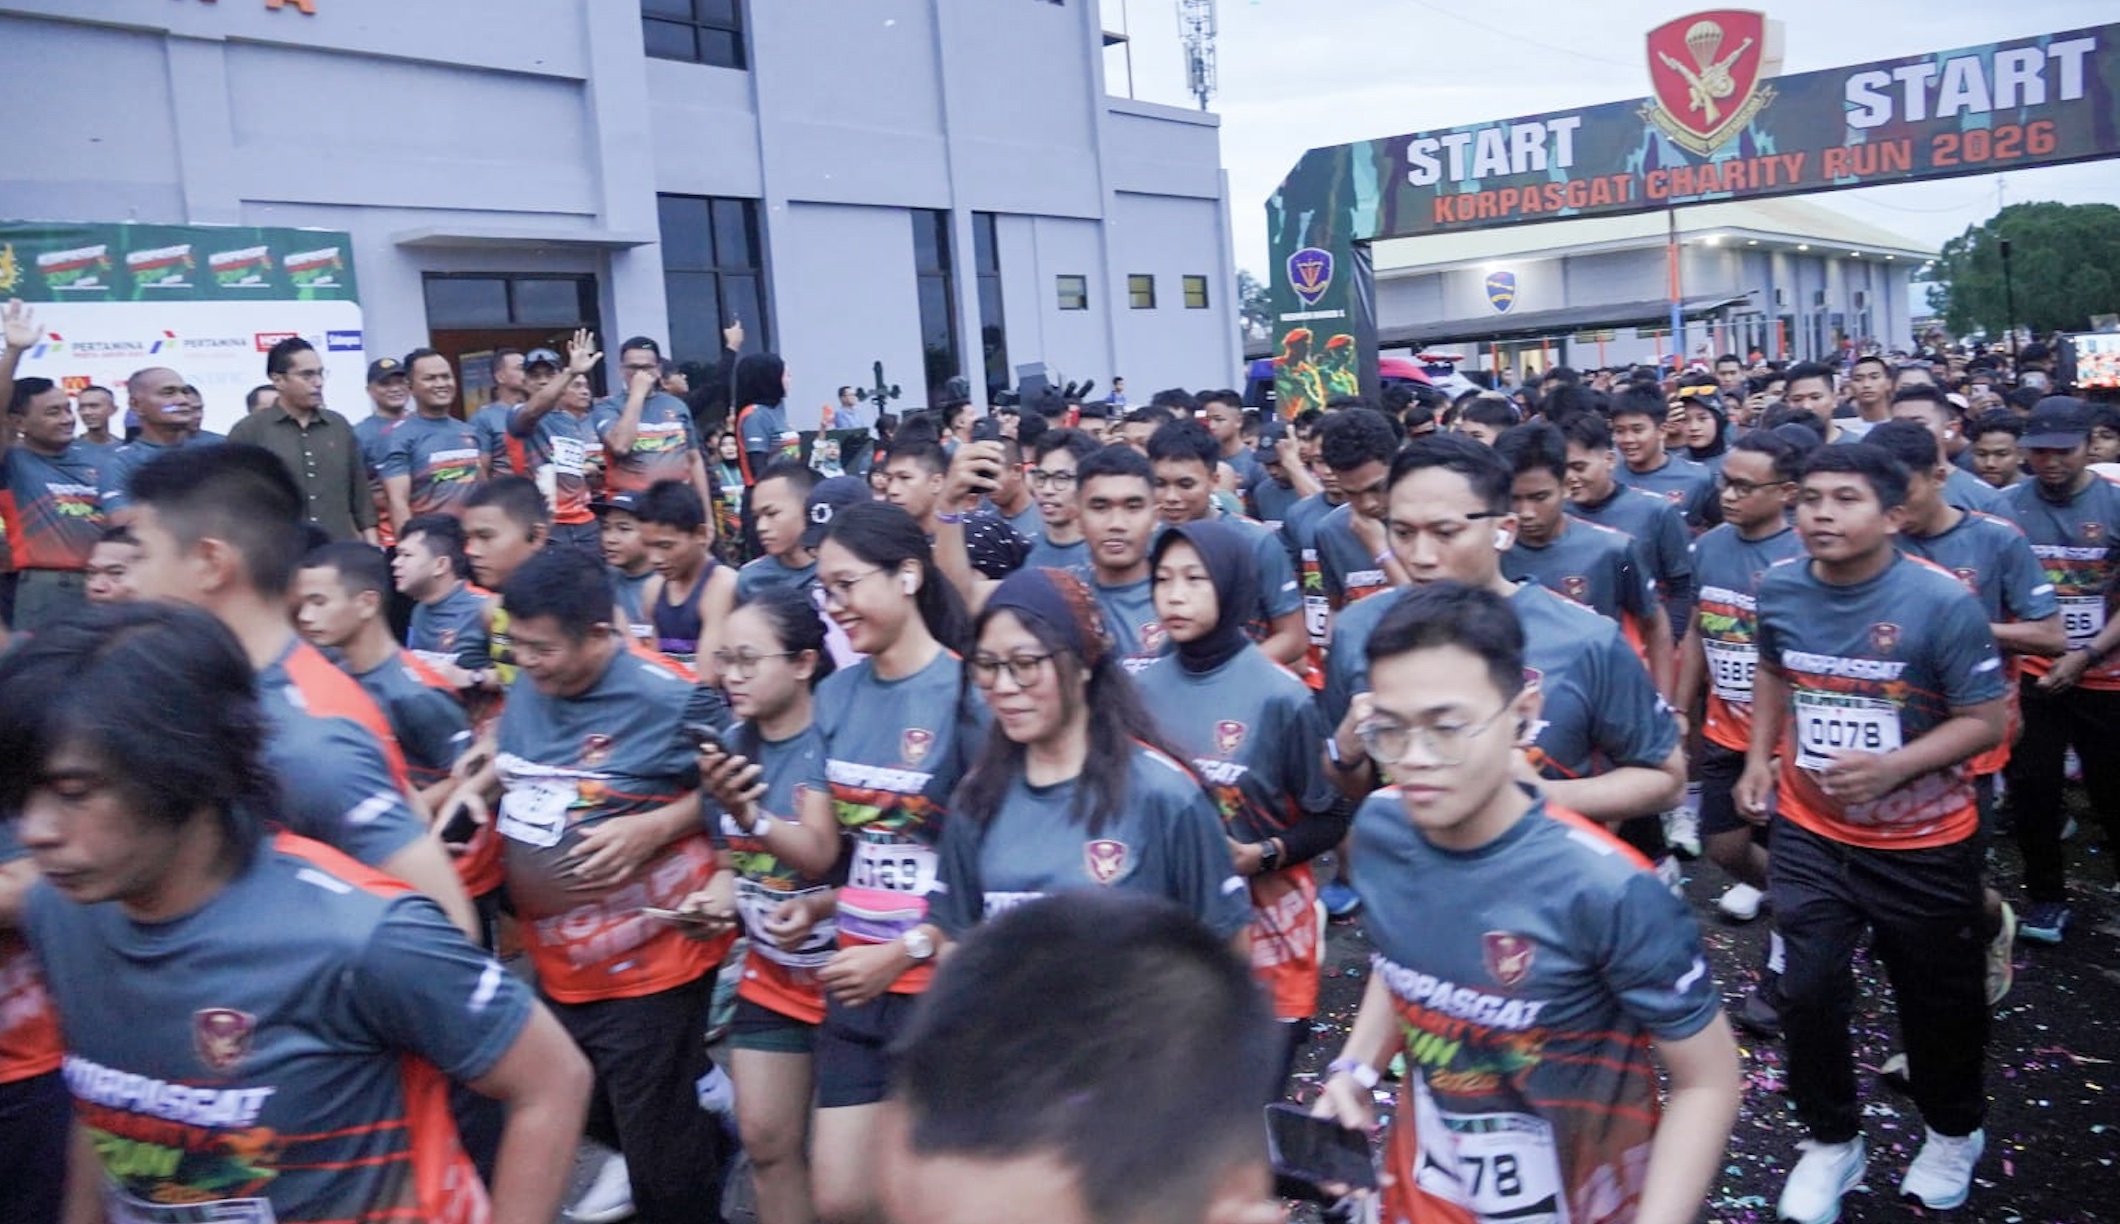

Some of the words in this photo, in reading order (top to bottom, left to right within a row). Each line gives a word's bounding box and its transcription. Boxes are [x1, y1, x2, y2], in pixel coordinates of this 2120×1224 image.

[1844, 36, 2097, 130] START
[1407, 116, 1582, 187] START
[1432, 172, 1630, 224] KORPASGAT
[1646, 151, 1806, 200] CHARITY
[1822, 138, 1912, 180] RUN
[1931, 120, 2056, 168] 2026
[72, 341, 144, 352] PERTAMINA
[183, 337, 247, 350] PERTAMINA
[1811, 718, 1881, 748] 0078
